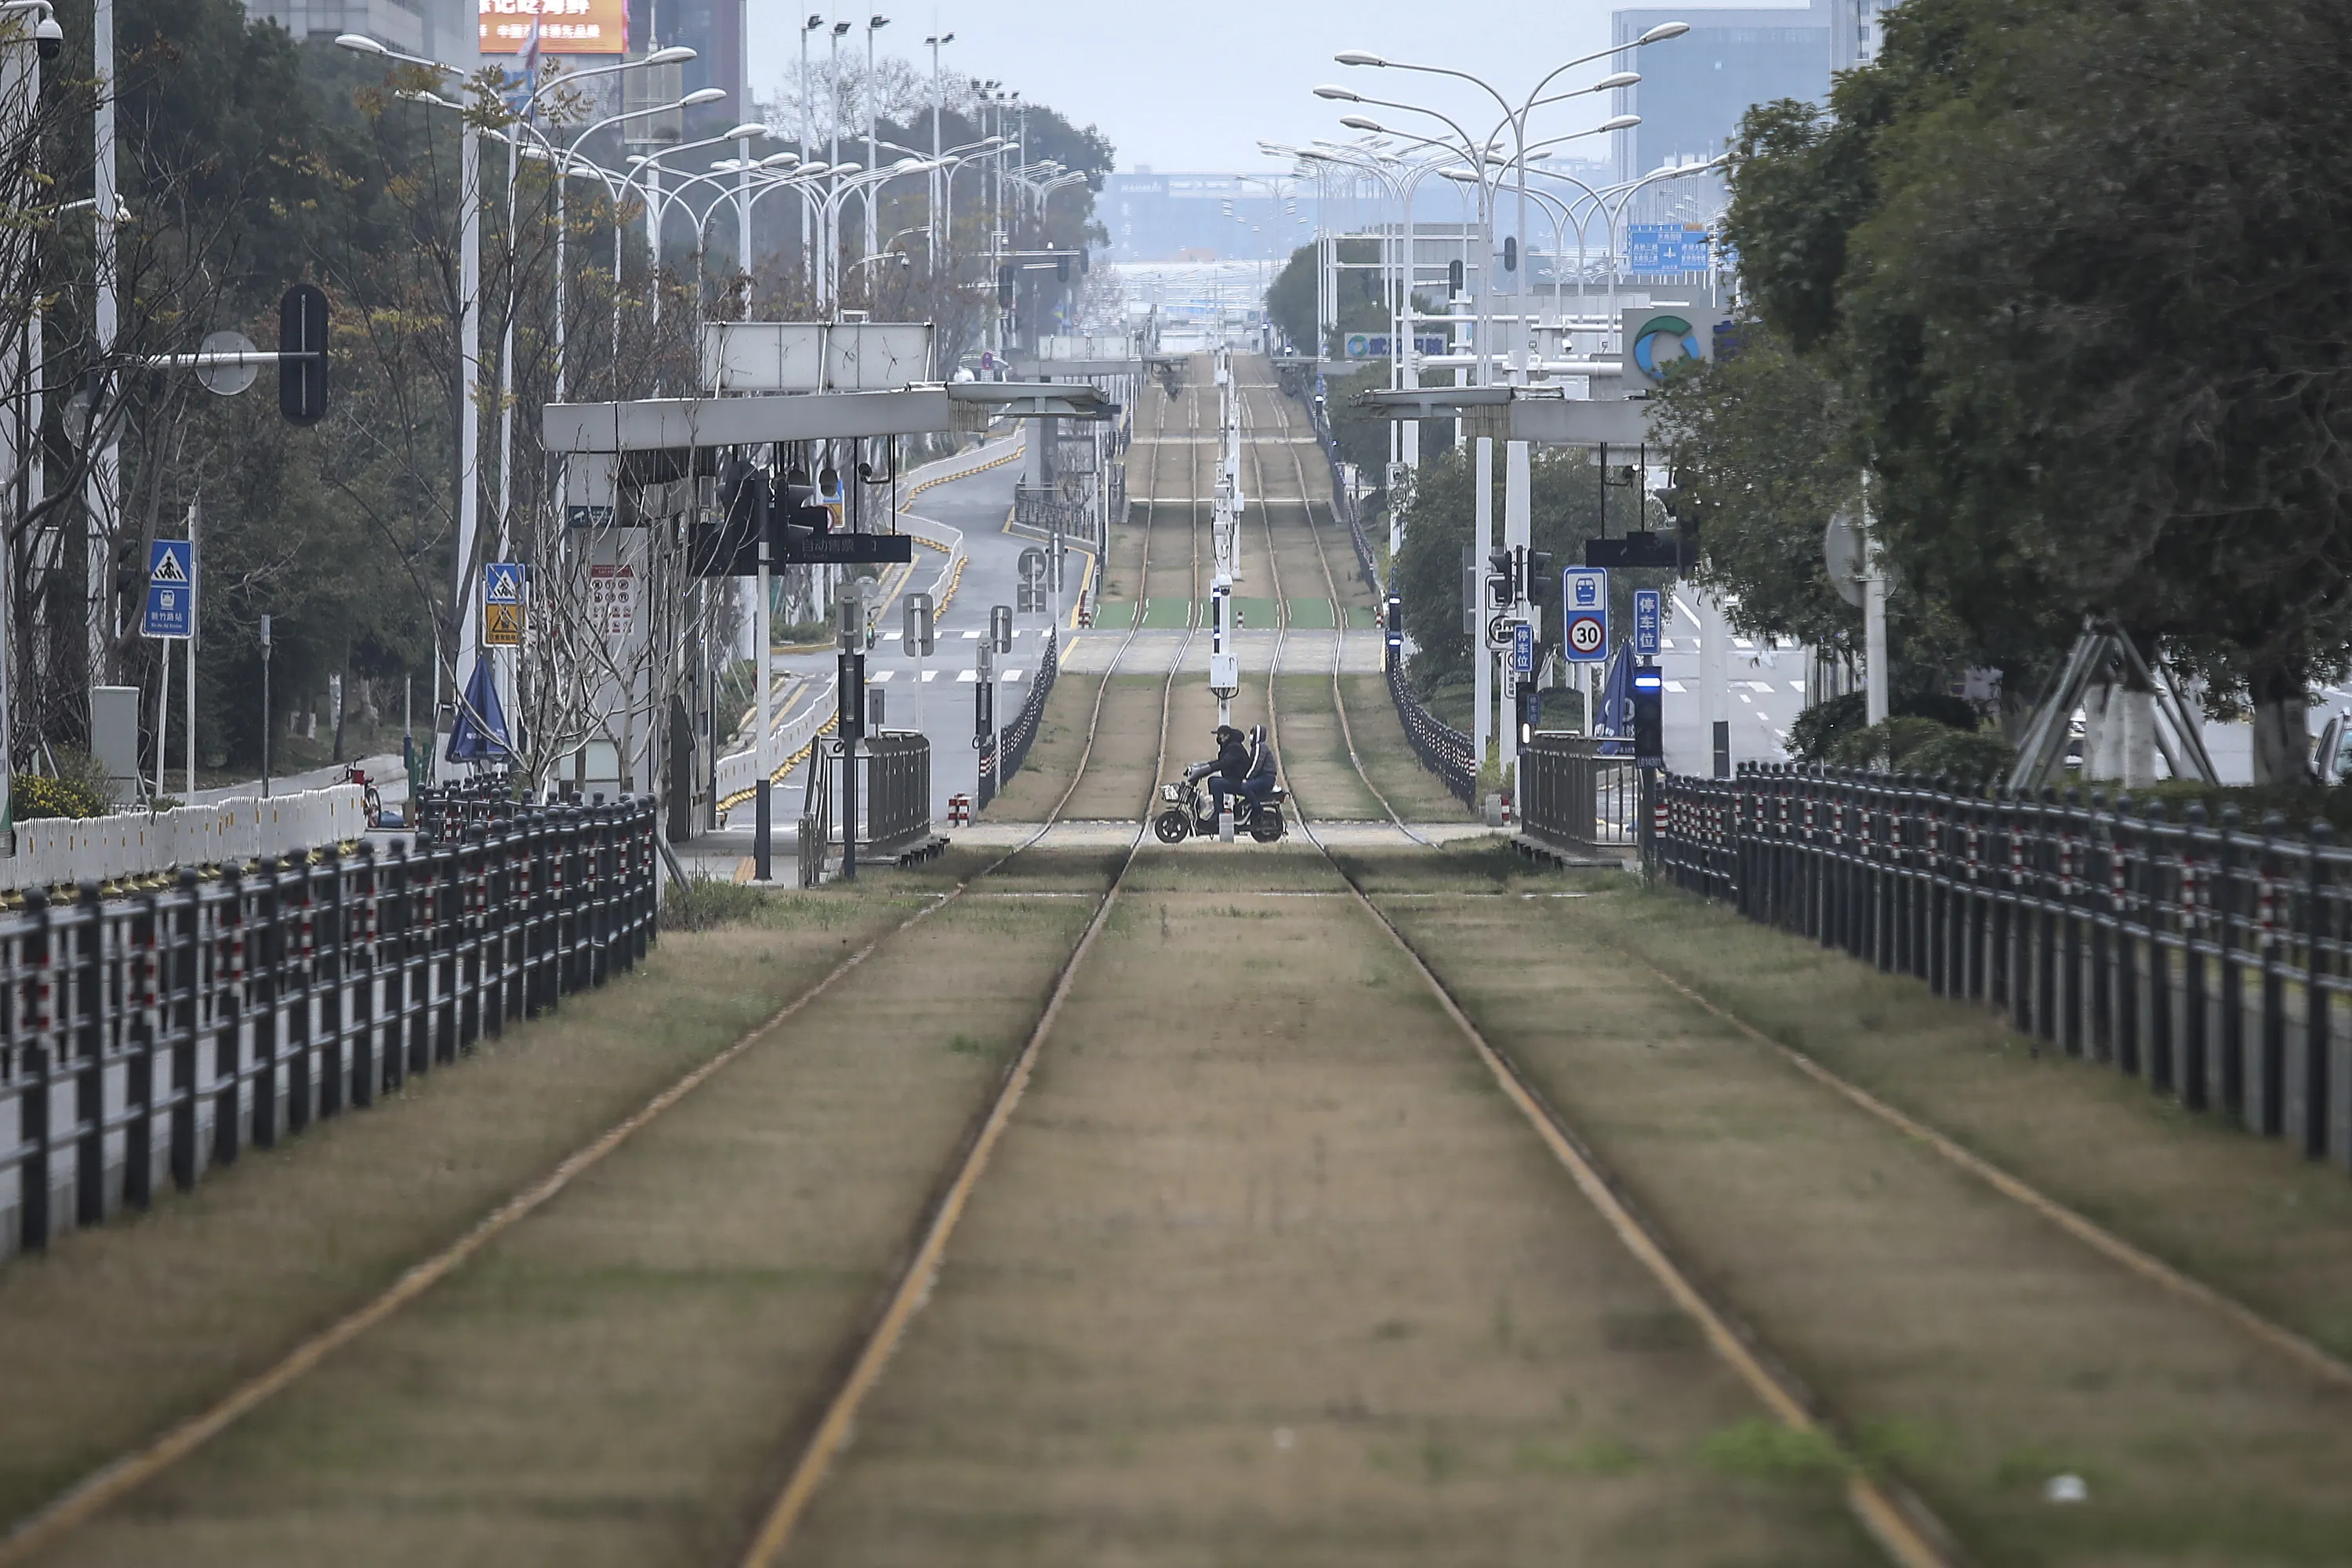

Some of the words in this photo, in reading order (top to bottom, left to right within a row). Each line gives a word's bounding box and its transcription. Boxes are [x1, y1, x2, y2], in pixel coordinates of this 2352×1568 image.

[1577, 627, 1598, 644] 30
[1639, 597, 1655, 648] 停车位
[1517, 630, 1529, 667] 停车位
